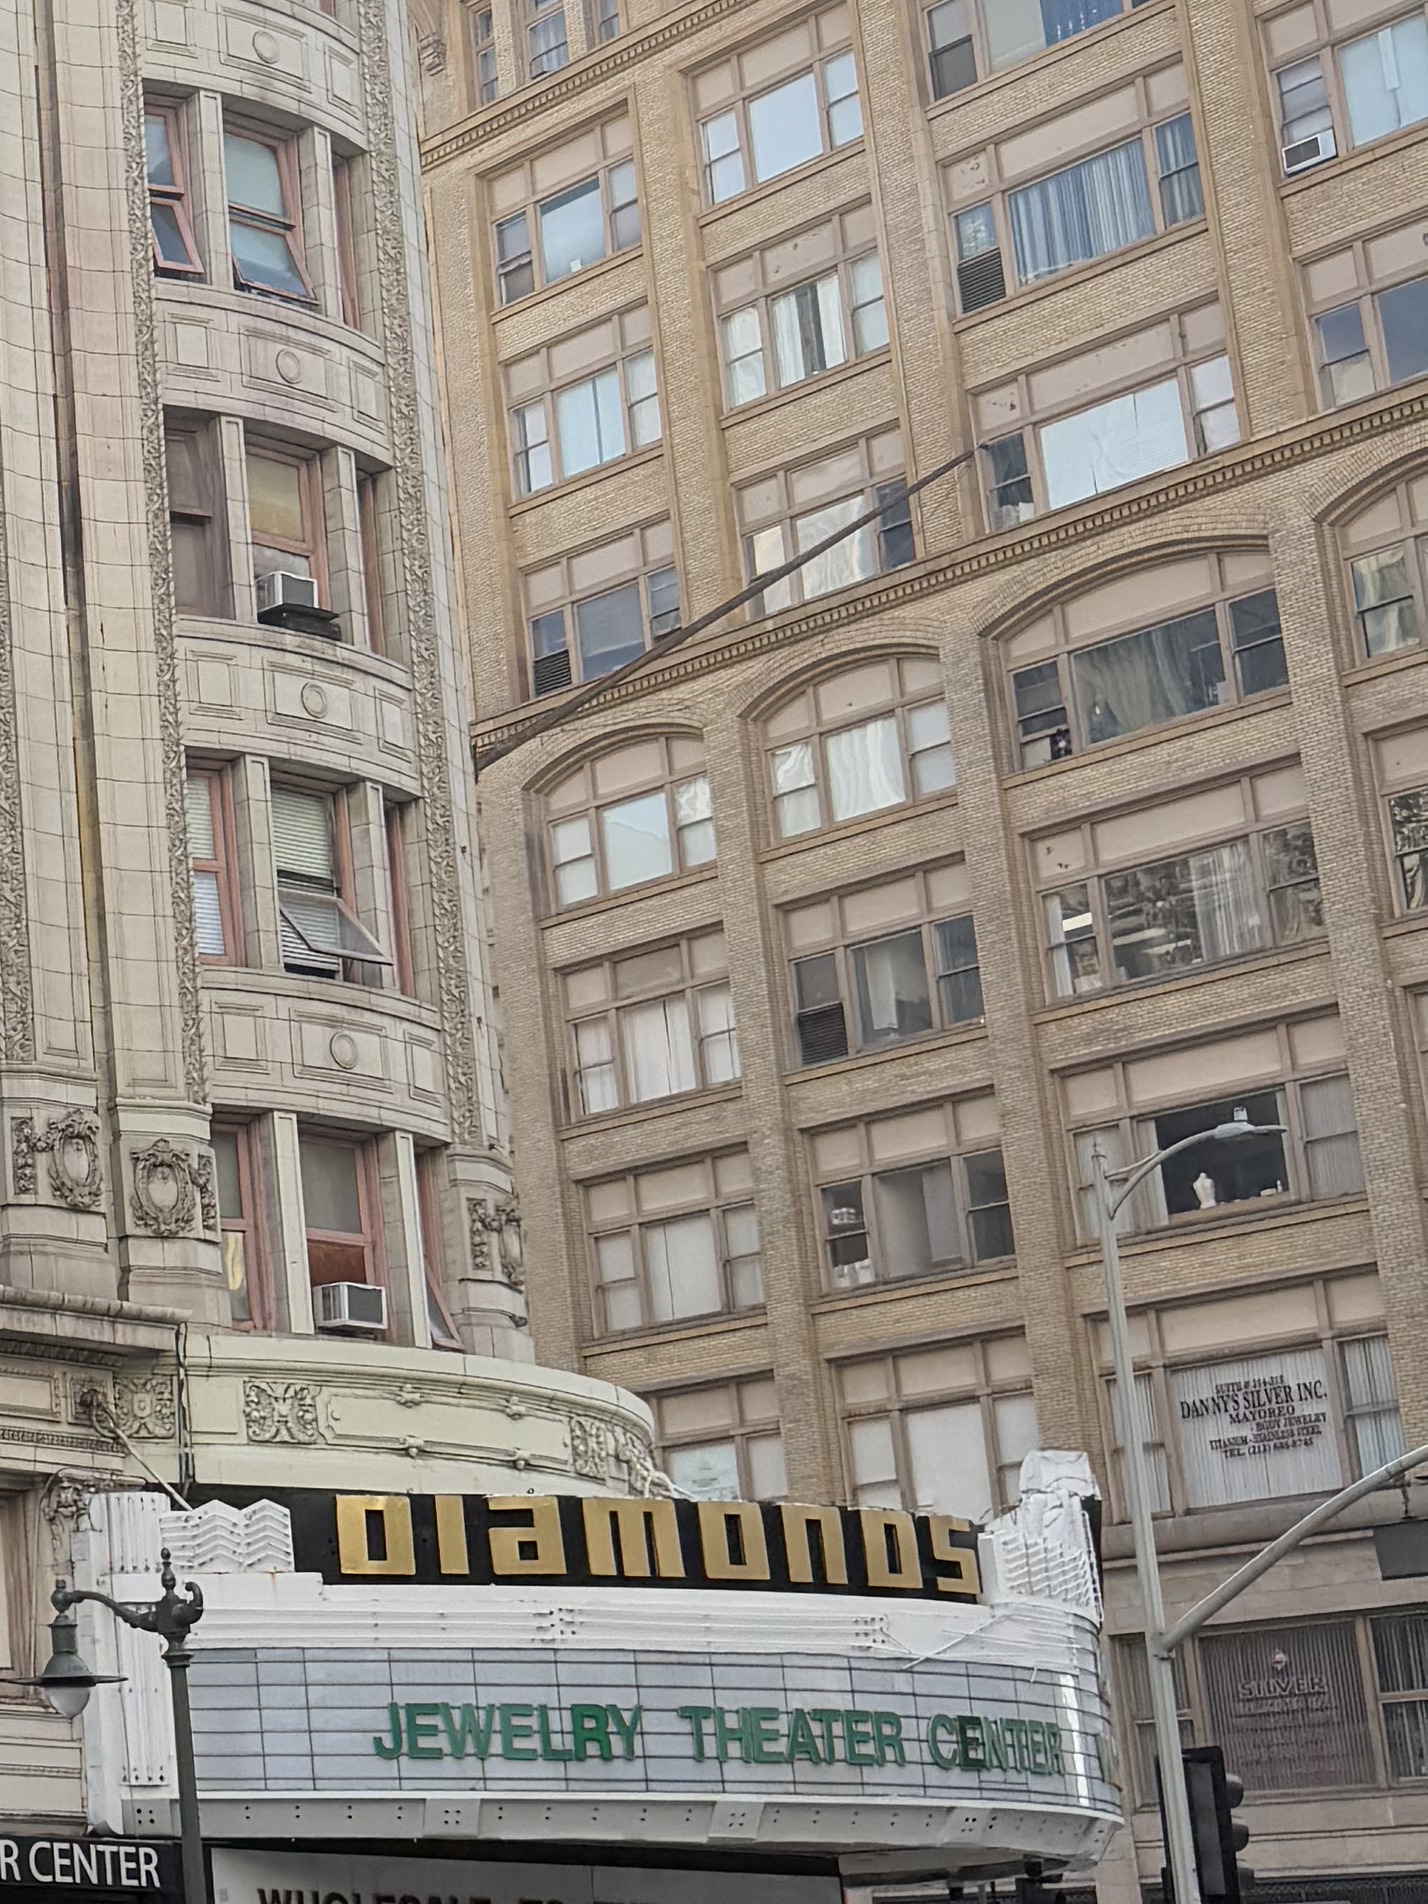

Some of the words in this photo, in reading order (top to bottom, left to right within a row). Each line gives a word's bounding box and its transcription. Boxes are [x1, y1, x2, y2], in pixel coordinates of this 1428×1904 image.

[1229, 1404, 1296, 1425] MAYOREO
[1243, 1384, 1294, 1411] SILVER
[1296, 1379, 1328, 1403] INC.
[372, 1702, 644, 1763] JEWELRY
[678, 1704, 906, 1768] THEATER
[928, 1713, 1067, 1777] CENTER
[28, 1838, 162, 1889] CENTER
